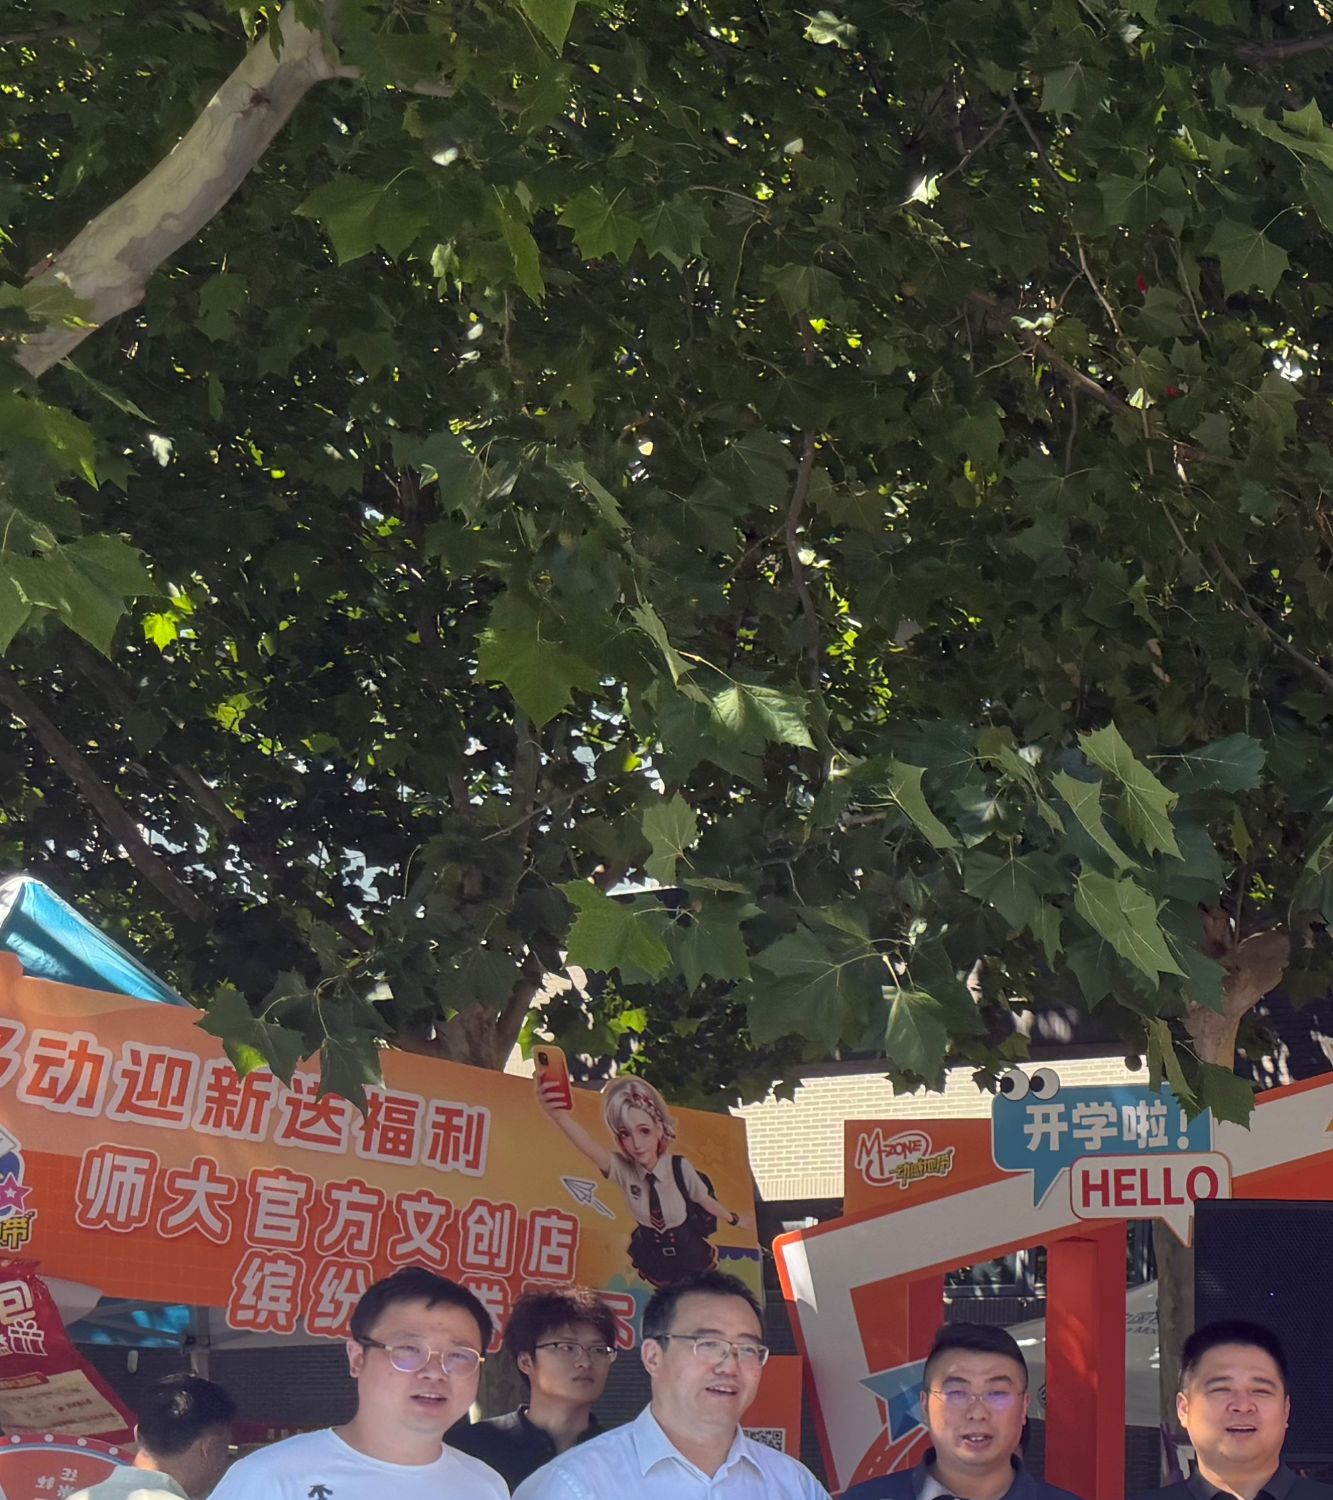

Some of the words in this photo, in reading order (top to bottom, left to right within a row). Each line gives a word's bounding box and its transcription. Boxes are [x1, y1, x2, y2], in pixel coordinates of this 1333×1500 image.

[78, 1146, 580, 1278] 师大官方文创店
[1081, 1166, 1219, 1207] HELLO
